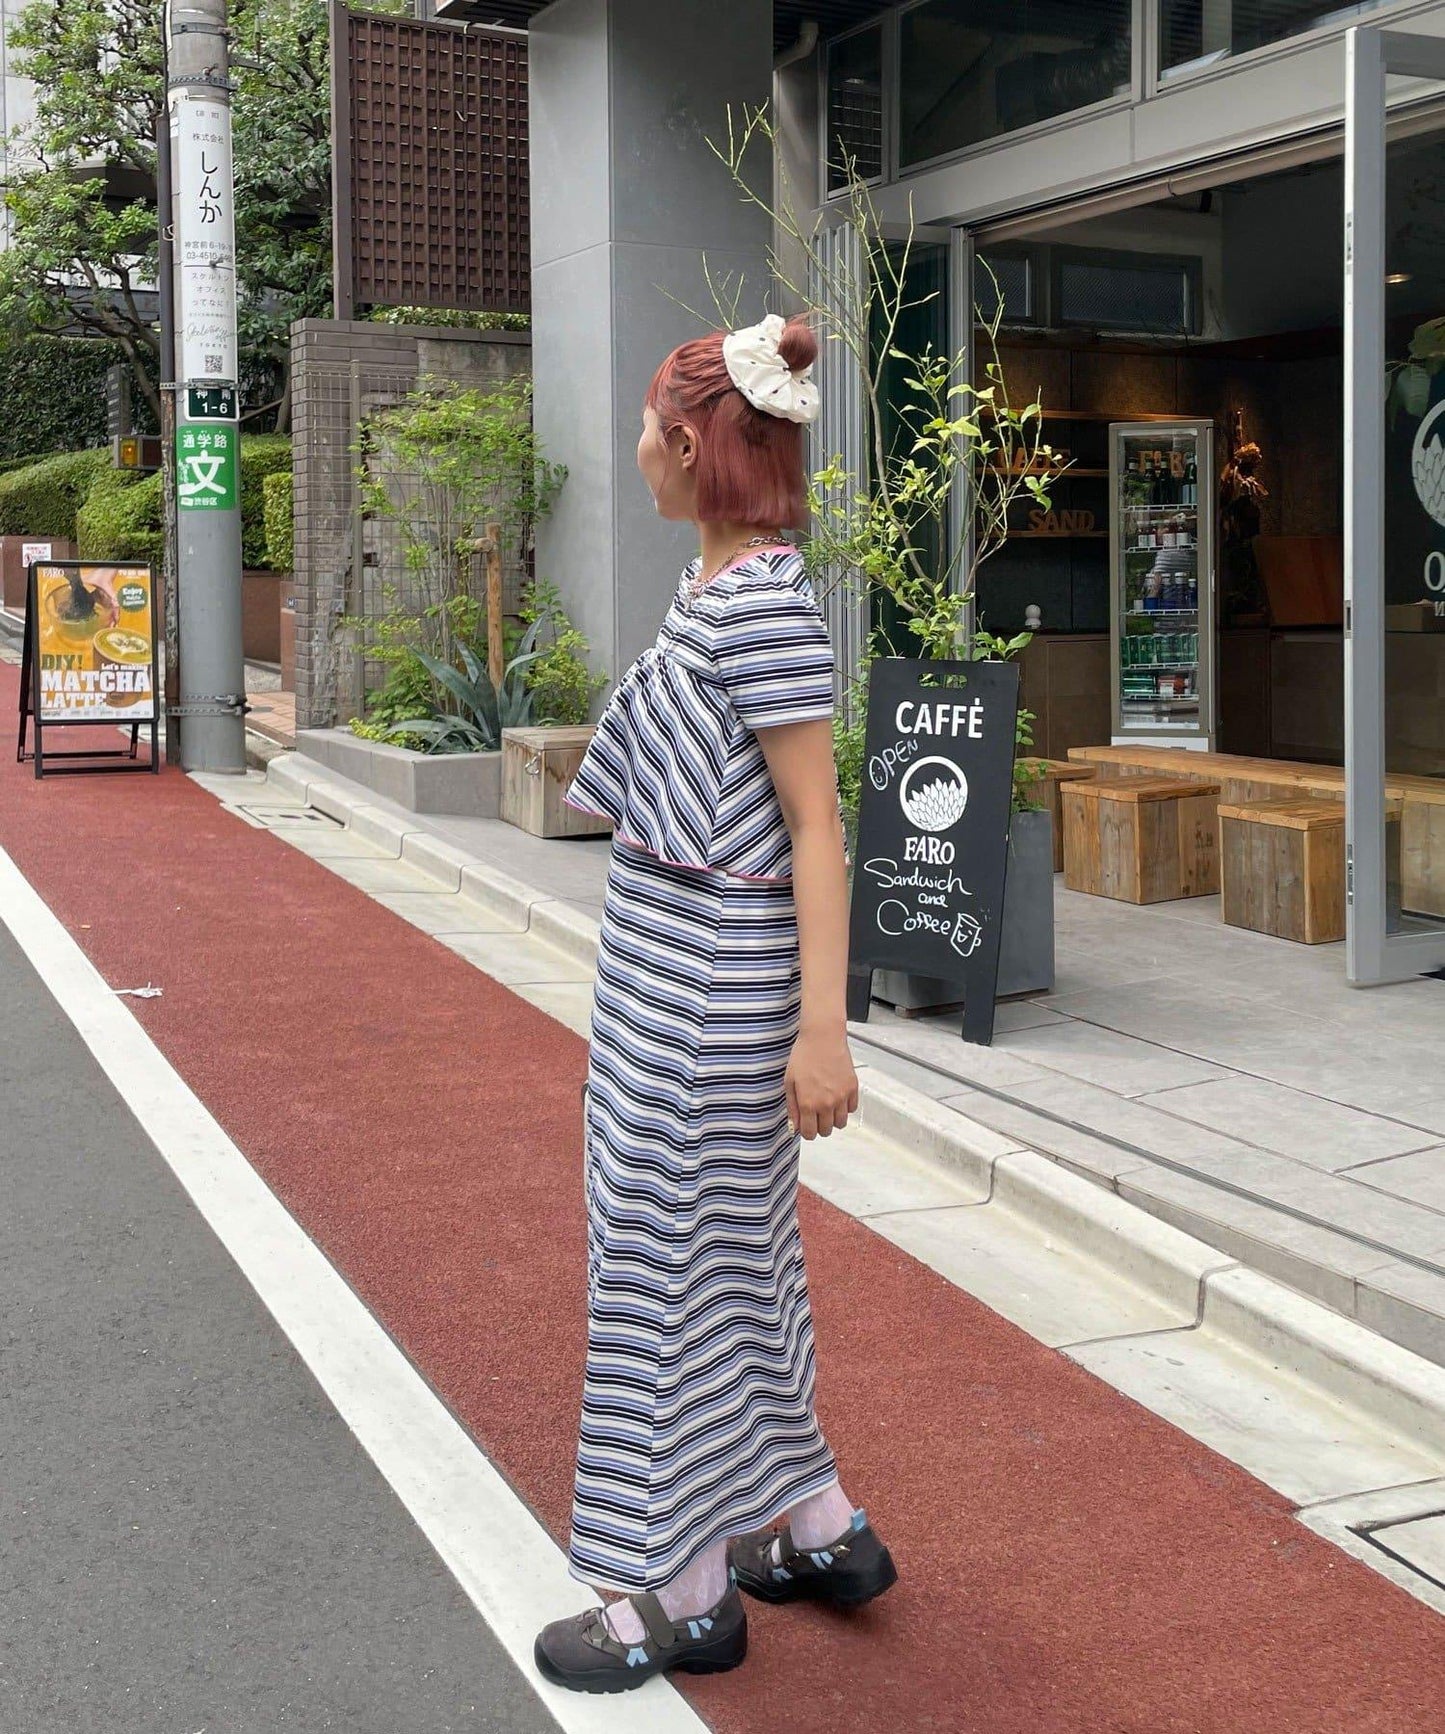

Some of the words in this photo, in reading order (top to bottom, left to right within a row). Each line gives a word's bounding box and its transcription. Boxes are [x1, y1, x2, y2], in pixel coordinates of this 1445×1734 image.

[199, 151, 223, 223] しんか
[202, 402, 228, 414] 1-6
[183, 434, 227, 448] 通学路
[1028, 508, 1095, 531] SAND
[42, 654, 83, 670] DIY!
[41, 670, 151, 692] MATCHA
[40, 692, 107, 709] LATTE
[868, 738, 919, 791] OPEN
[903, 835, 956, 865] FARO
[864, 857, 973, 896] Sandwich
[877, 899, 951, 936] Coffee
